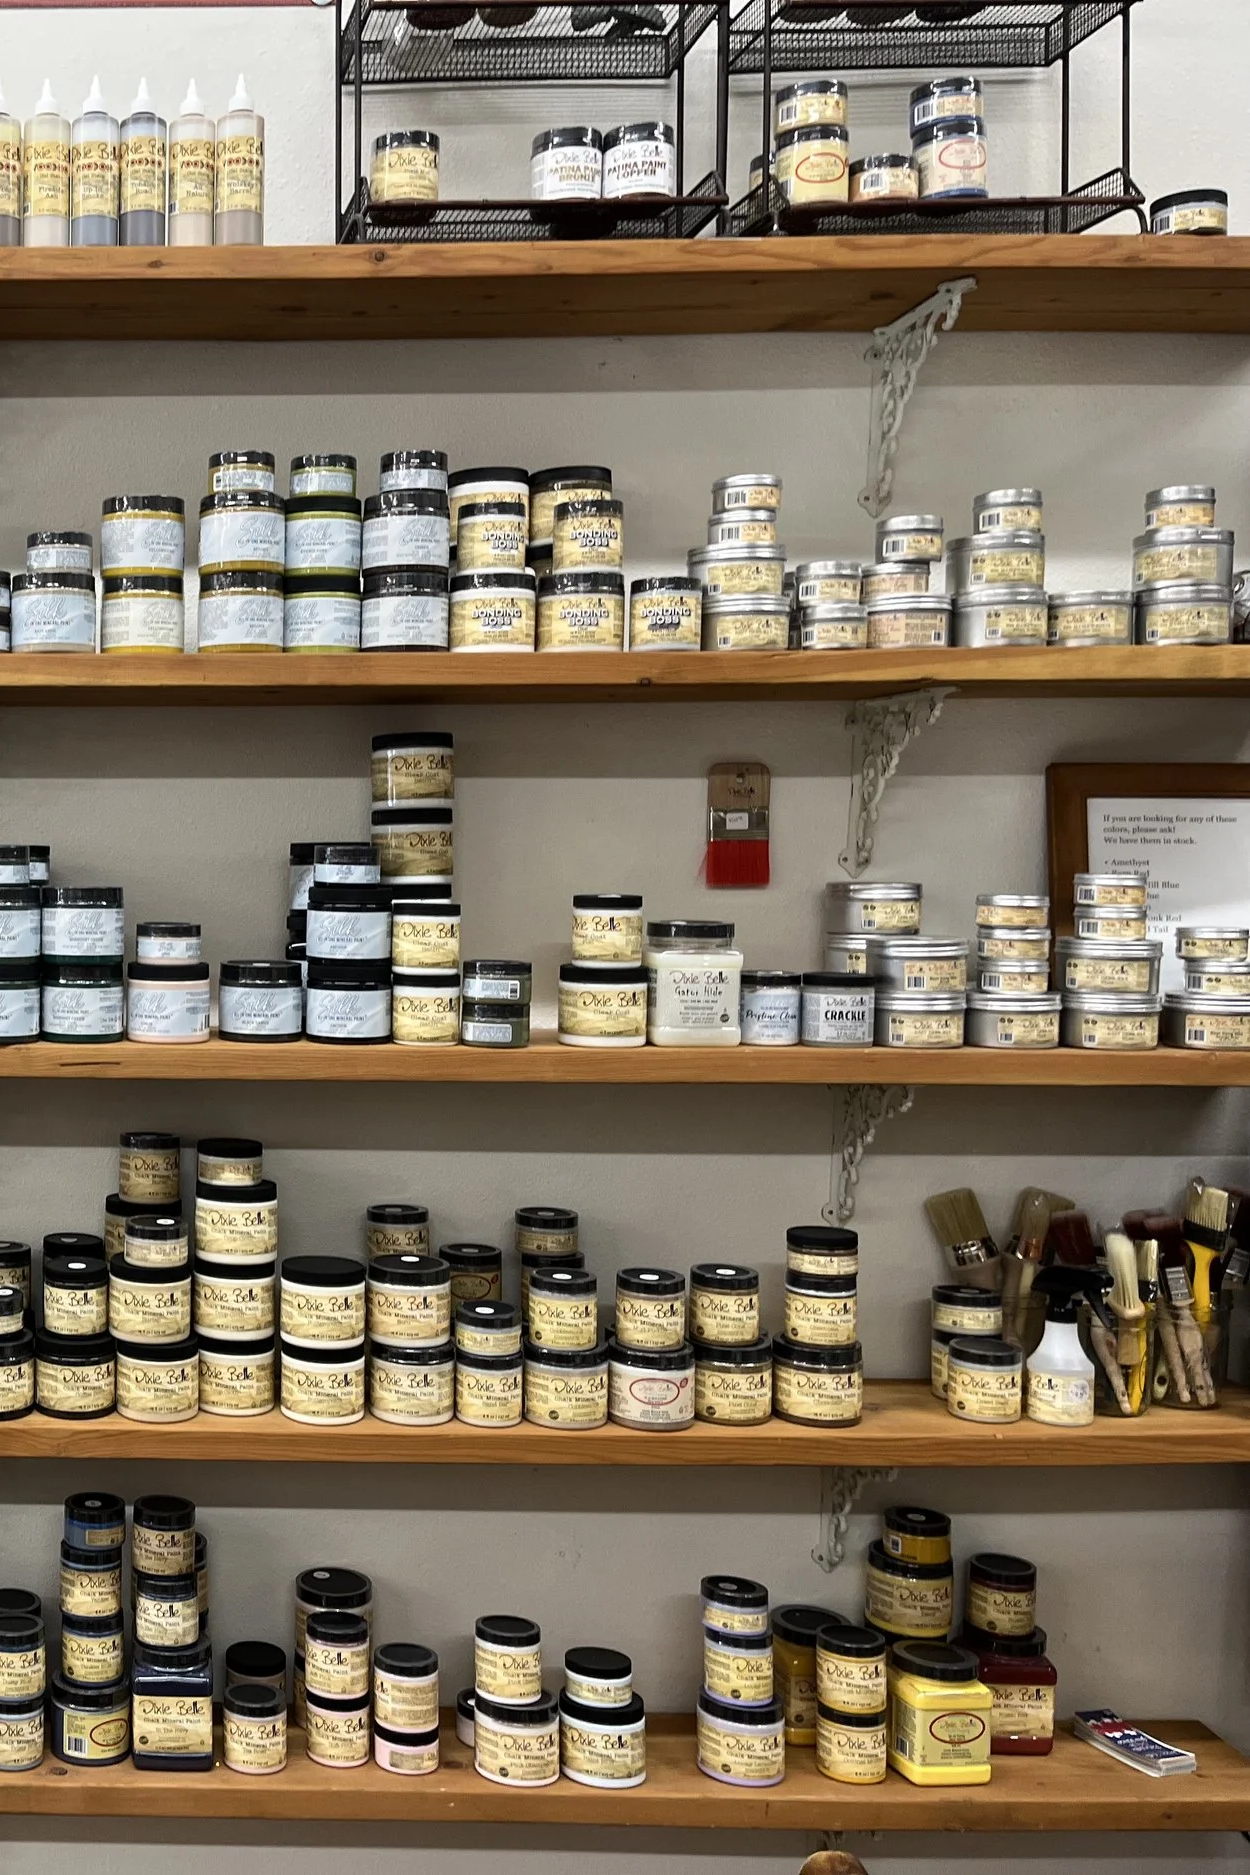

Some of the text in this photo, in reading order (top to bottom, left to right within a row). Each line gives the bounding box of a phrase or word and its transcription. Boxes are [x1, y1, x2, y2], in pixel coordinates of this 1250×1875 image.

[388, 152, 417, 168] Dixie
[642, 160, 666, 170] PAINT
[482, 532, 525, 543] BONDING
[569, 530, 618, 540] BONDING
[491, 540, 518, 550] BOSS
[578, 537, 609, 547] BOSS
[471, 609, 521, 619] BONDING
[559, 609, 609, 620] BONDING
[640, 606, 691, 617] BONDING
[481, 617, 511, 626] BOSS
[568, 617, 599, 626] BOSS
[648, 615, 680, 625] BOSS
[391, 754, 449, 772] Dixie Belle
[1144, 815, 1173, 823] looking
[1190, 816, 1203, 824] any
[1103, 826, 1130, 834] colors,
[1132, 826, 1158, 834] please
[592, 916, 622, 932] Belle
[401, 922, 458, 939] Dixie Belle
[670, 971, 729, 985] Dixie Belle
[675, 986, 723, 997] Gator Hide
[399, 996, 457, 1013] Dixie Belle
[580, 990, 641, 1009] Dixie Belle
[824, 1010, 866, 1021] CRACKLE
[211, 1211, 267, 1226] Dixie Belle
[375, 1293, 434, 1310] Dixie Belle
[826, 1662, 854, 1680] Dixie
[1019, 1689, 1047, 1701] Belle
[139, 1700, 205, 1715] Dixie Belle
[565, 1727, 630, 1751] Dixie Belle
